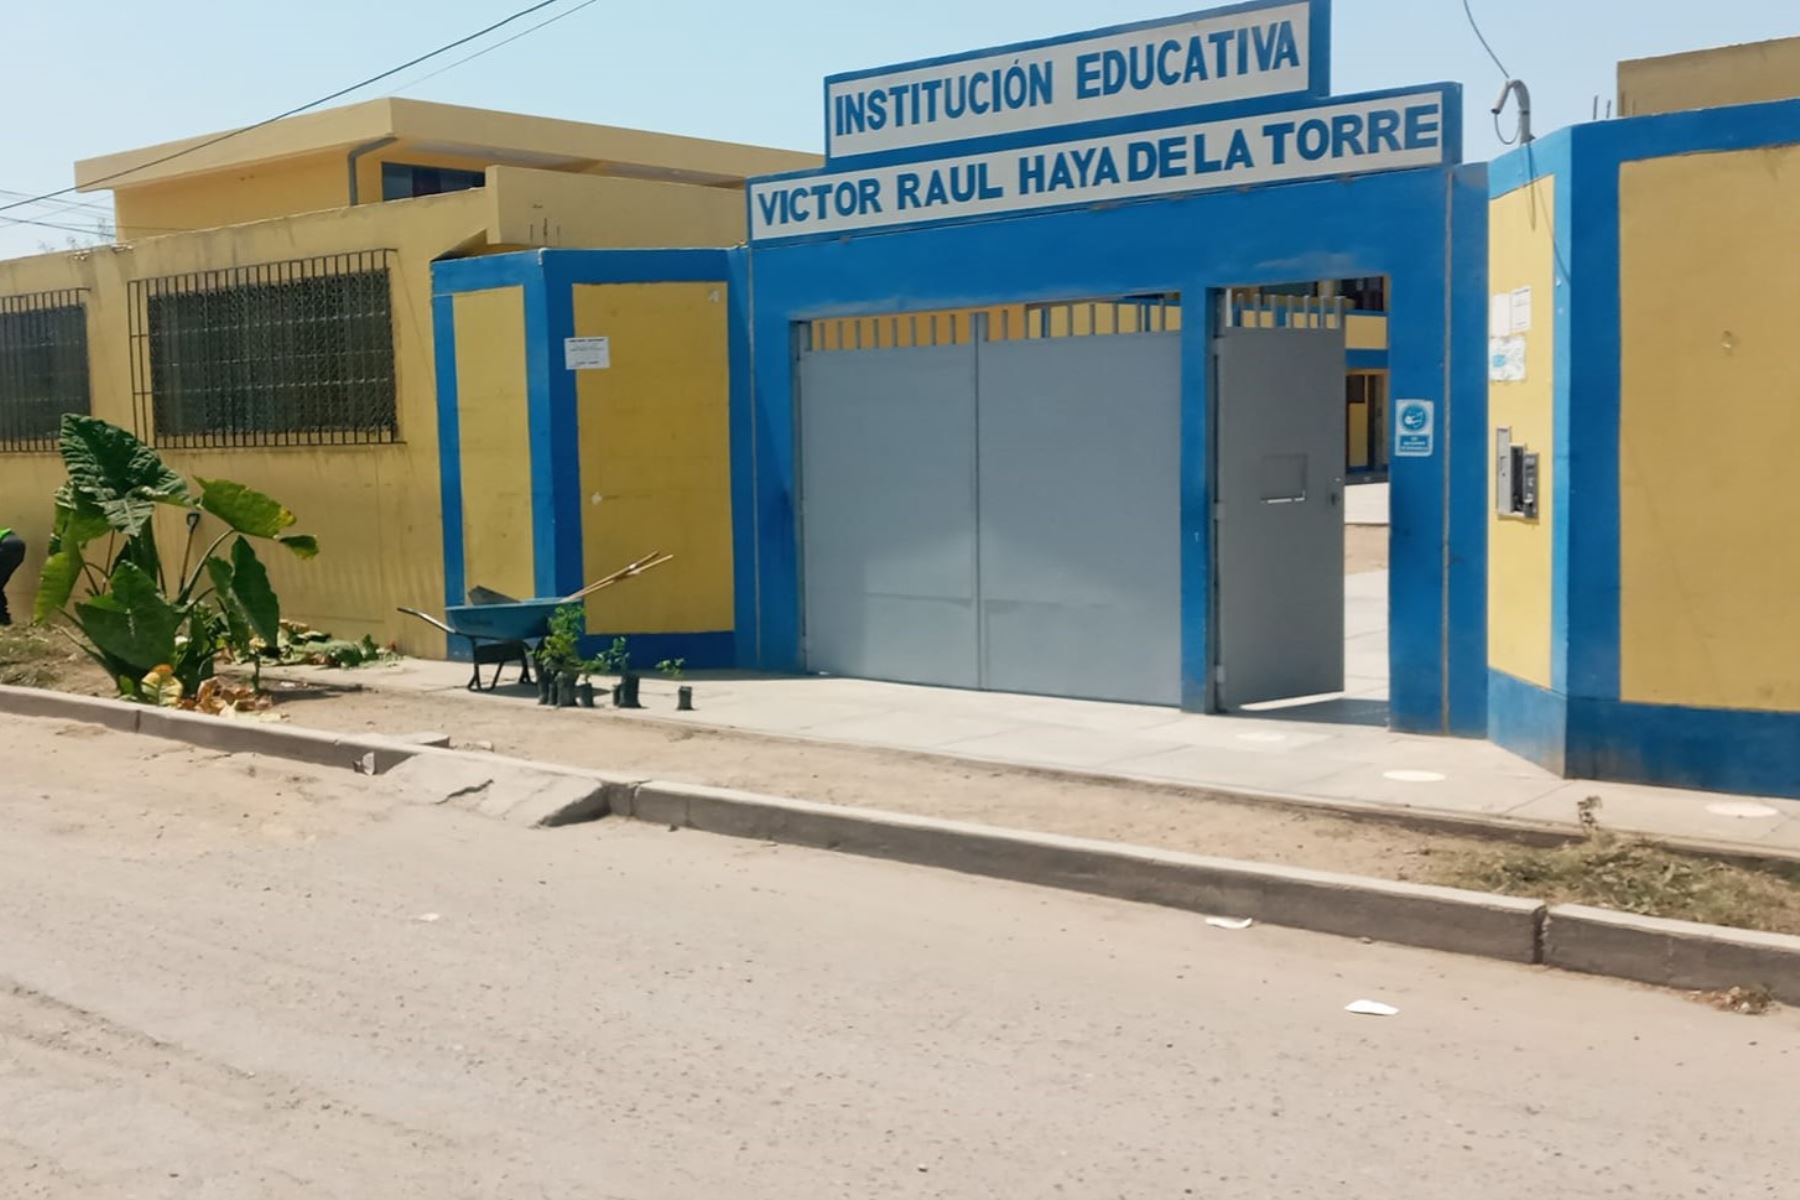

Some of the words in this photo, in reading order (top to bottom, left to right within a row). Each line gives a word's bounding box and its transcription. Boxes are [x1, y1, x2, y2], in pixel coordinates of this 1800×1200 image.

[834, 58, 1055, 137] INSTITUCIÓN
[1075, 21, 1301, 99] EDUCATIVA
[757, 177, 883, 227] VICTOR
[896, 162, 1005, 211] RAUL
[1018, 146, 1120, 195] HAYA
[1127, 135, 1188, 183] DE
[1193, 129, 1255, 174] LA
[1262, 103, 1441, 166] TORRE
